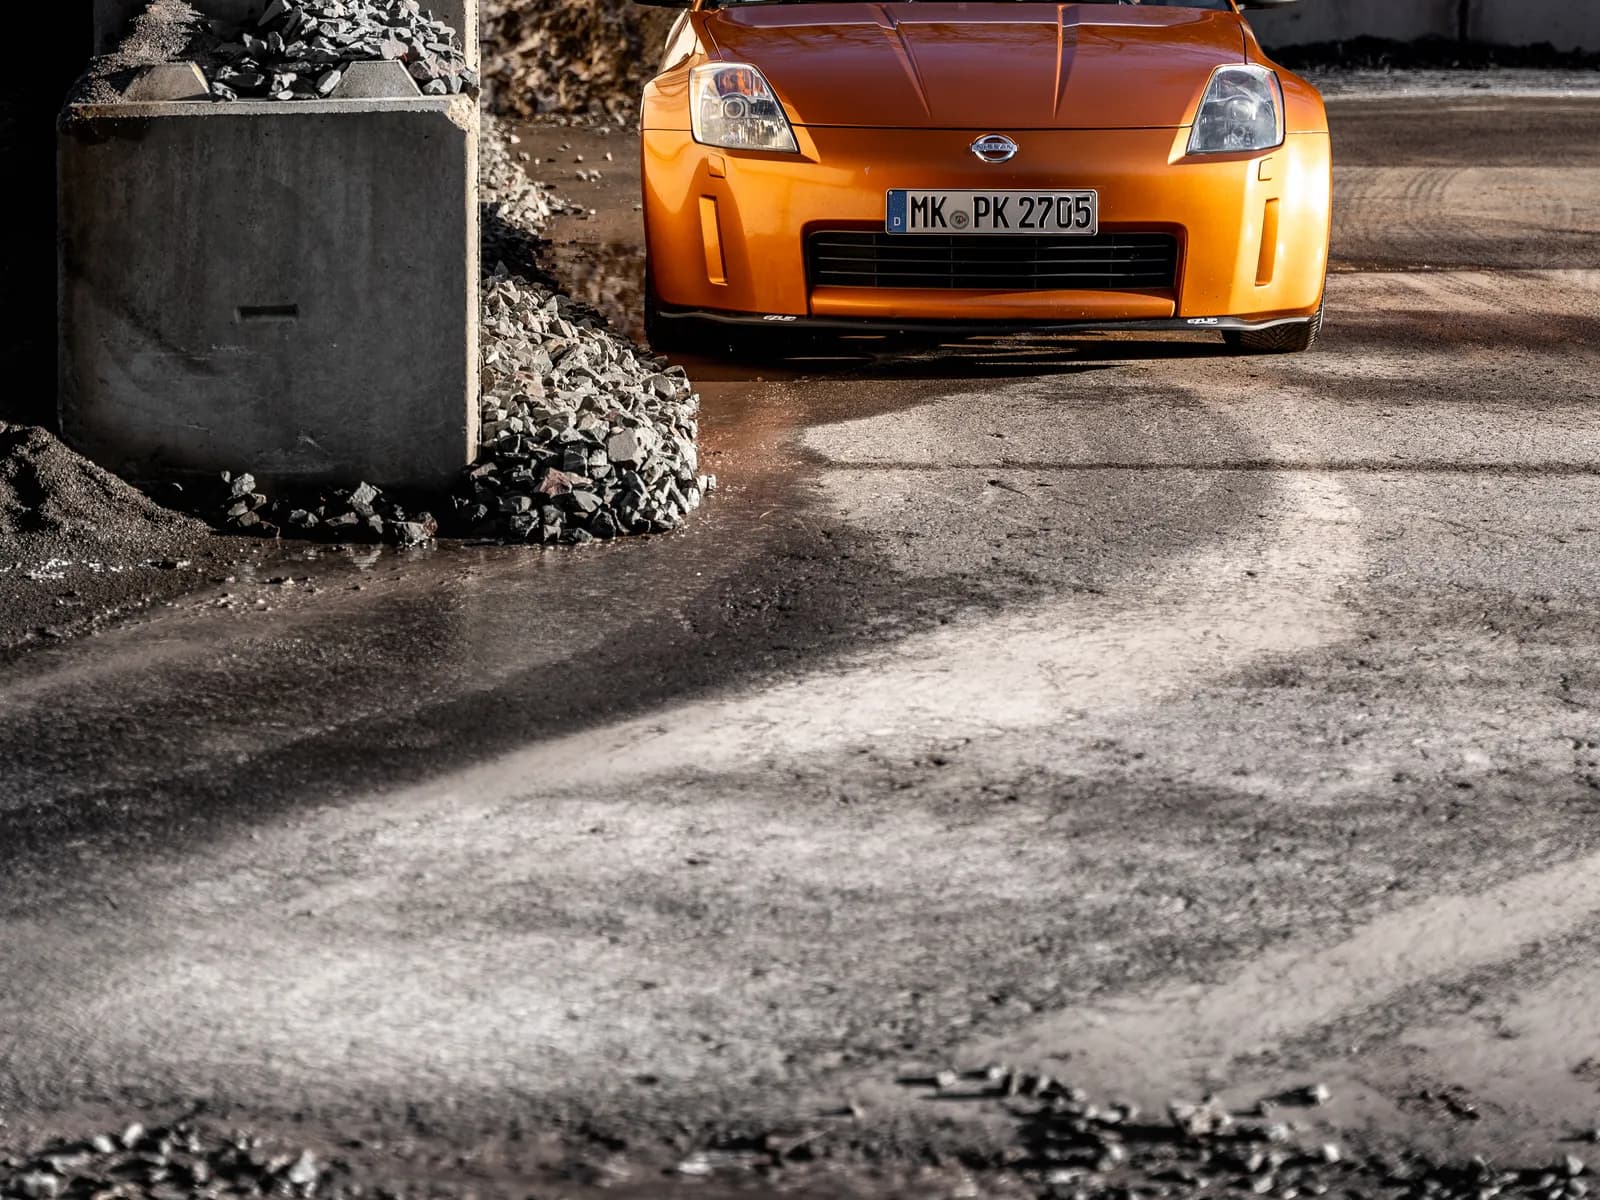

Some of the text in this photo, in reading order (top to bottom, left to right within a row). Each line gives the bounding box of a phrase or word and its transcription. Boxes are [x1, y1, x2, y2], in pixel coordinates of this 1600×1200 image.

[893, 195, 1092, 228] D MK PK 2705
